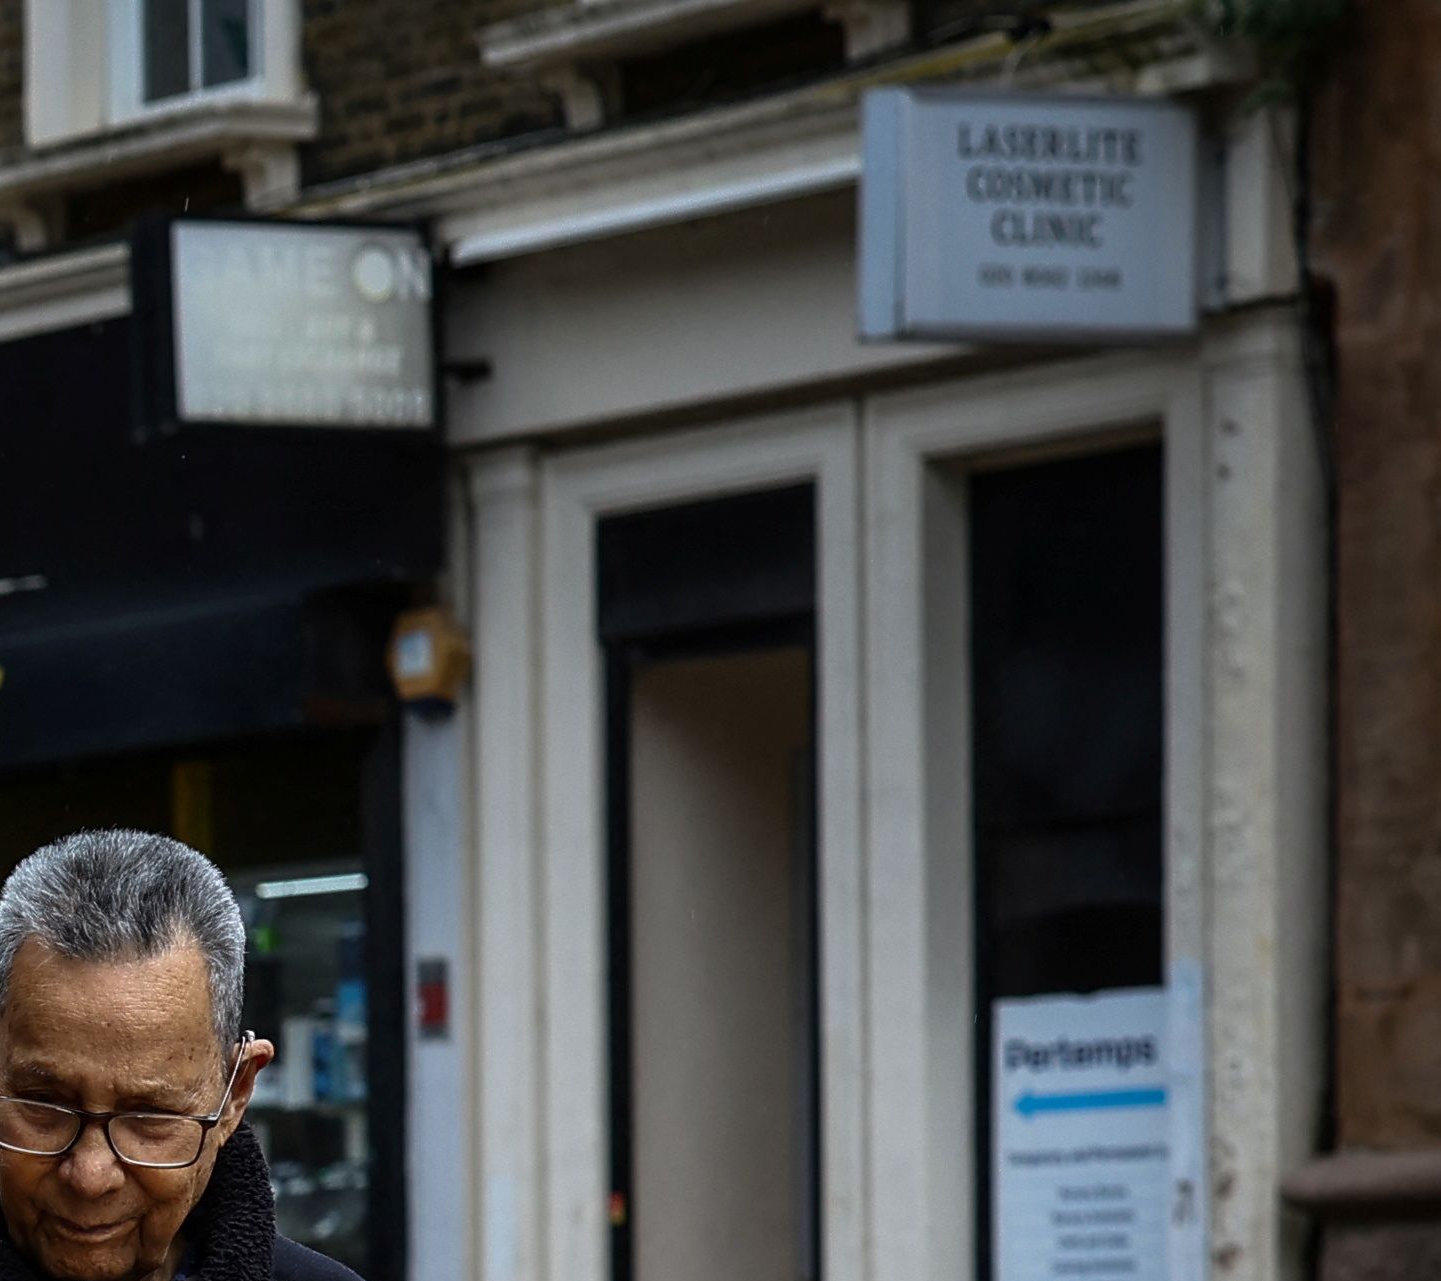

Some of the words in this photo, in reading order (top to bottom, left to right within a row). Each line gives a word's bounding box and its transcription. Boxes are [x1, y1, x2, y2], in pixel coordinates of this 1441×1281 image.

[957, 122, 1142, 166] LASERLITE
[965, 165, 1134, 209] COSMETIC
[990, 207, 1104, 248] CLINIC
